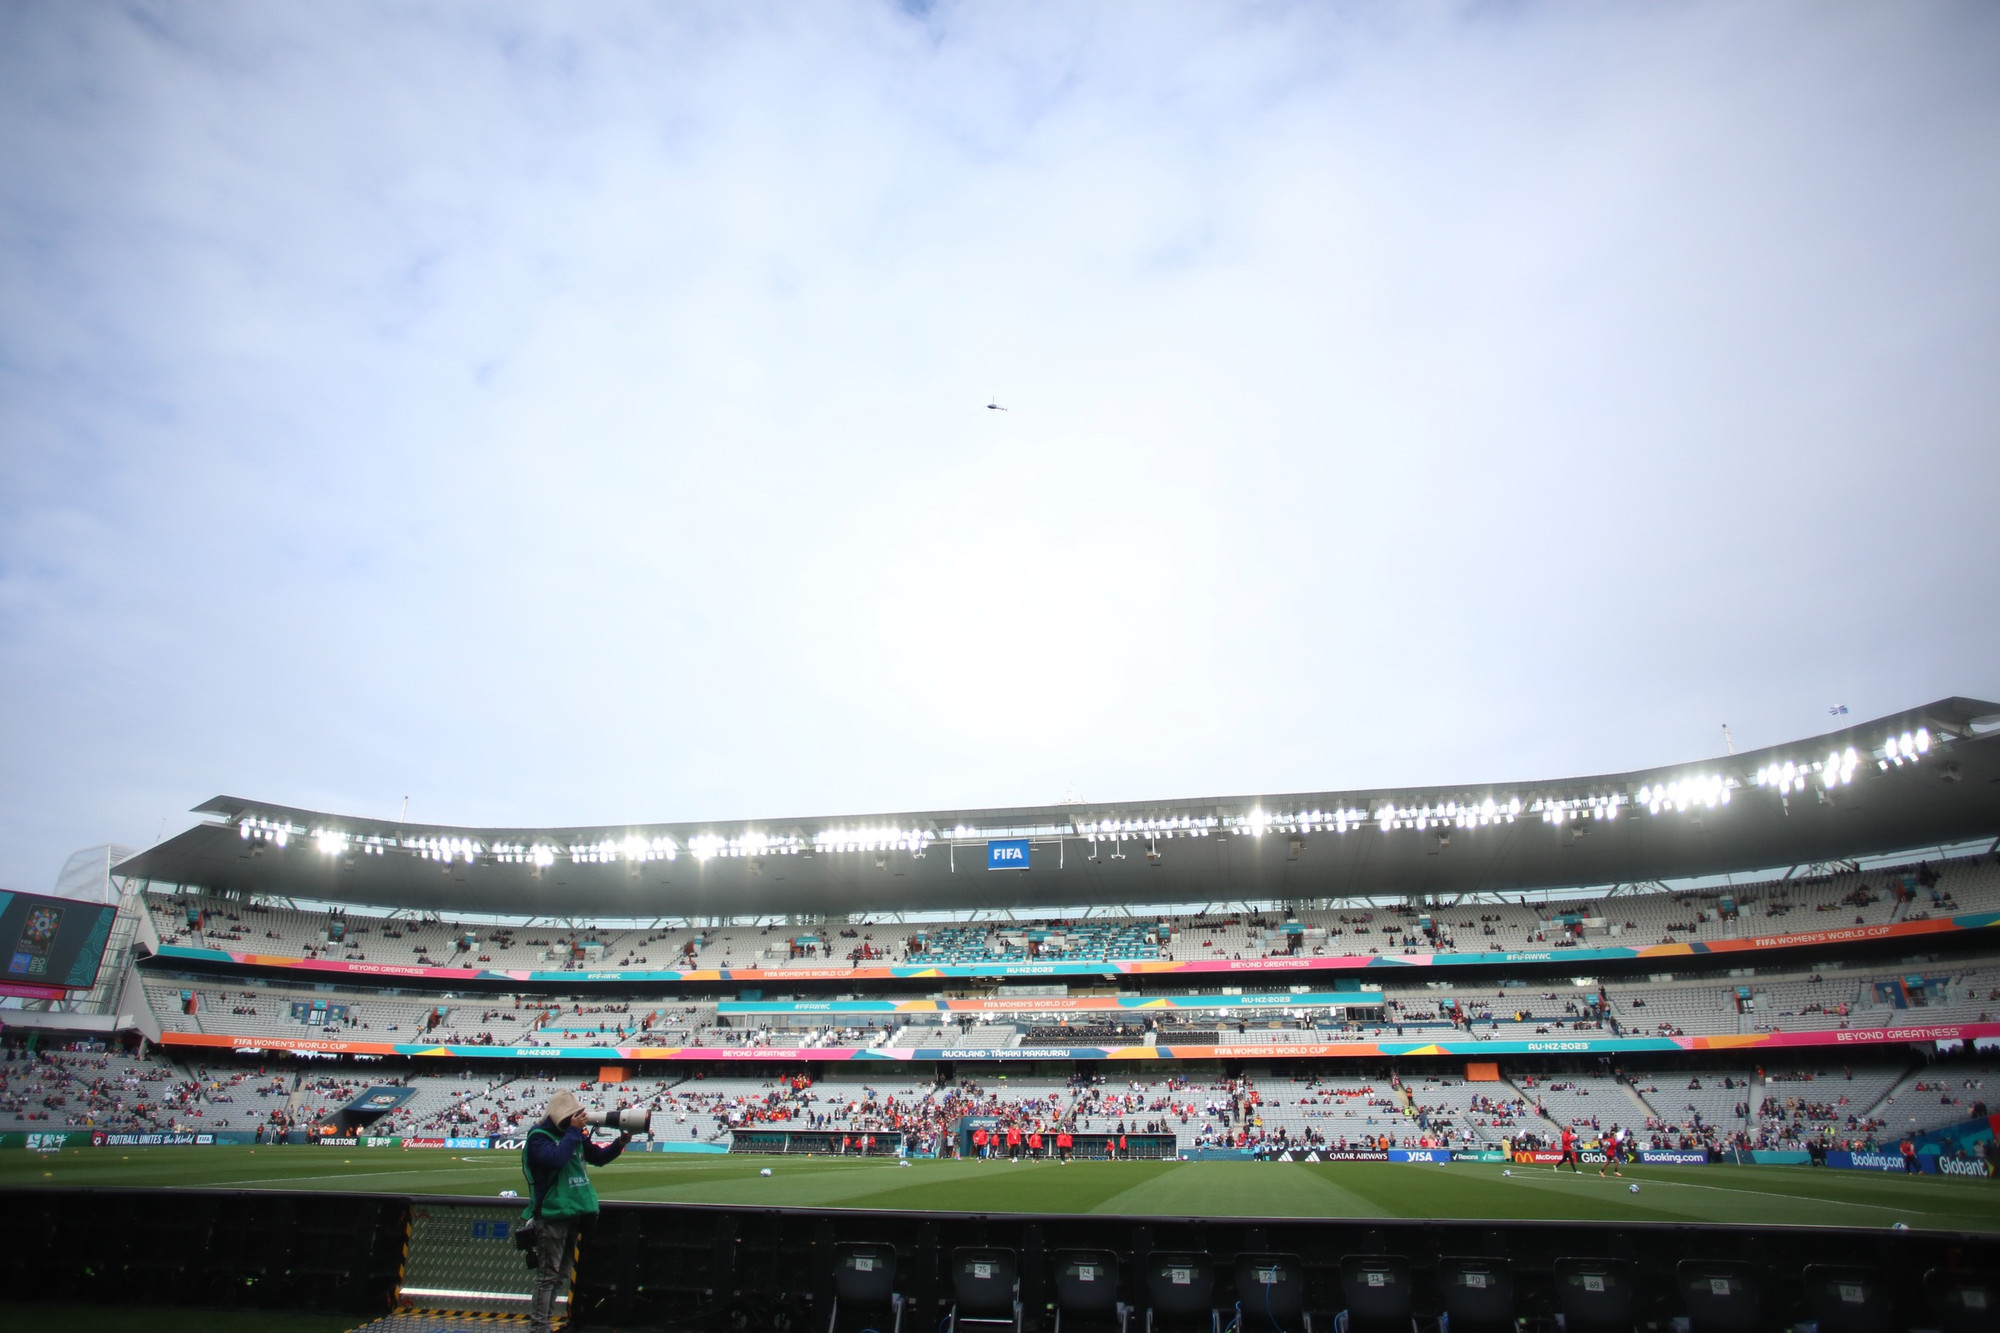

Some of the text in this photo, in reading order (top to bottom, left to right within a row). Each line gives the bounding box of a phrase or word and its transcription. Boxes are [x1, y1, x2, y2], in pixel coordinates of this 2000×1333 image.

[994, 848, 1022, 860] FIFA
[1778, 934, 1826, 944] WOMEN'S
[1828, 930, 1865, 940] WORLD
[1868, 927, 1889, 936] CUP
[381, 966, 424, 974] GREATNESS
[1837, 1028, 1959, 1041] BEYOND GREATNESS
[106, 1134, 195, 1145] FOOTBALL UNITES the World
[401, 1138, 444, 1148] Budweiser
[1406, 1152, 1433, 1161] VISA
[1644, 1153, 1703, 1163] Booking.com
[1939, 1156, 1988, 1176] Globant
[1715, 1281, 1725, 1290] 68
